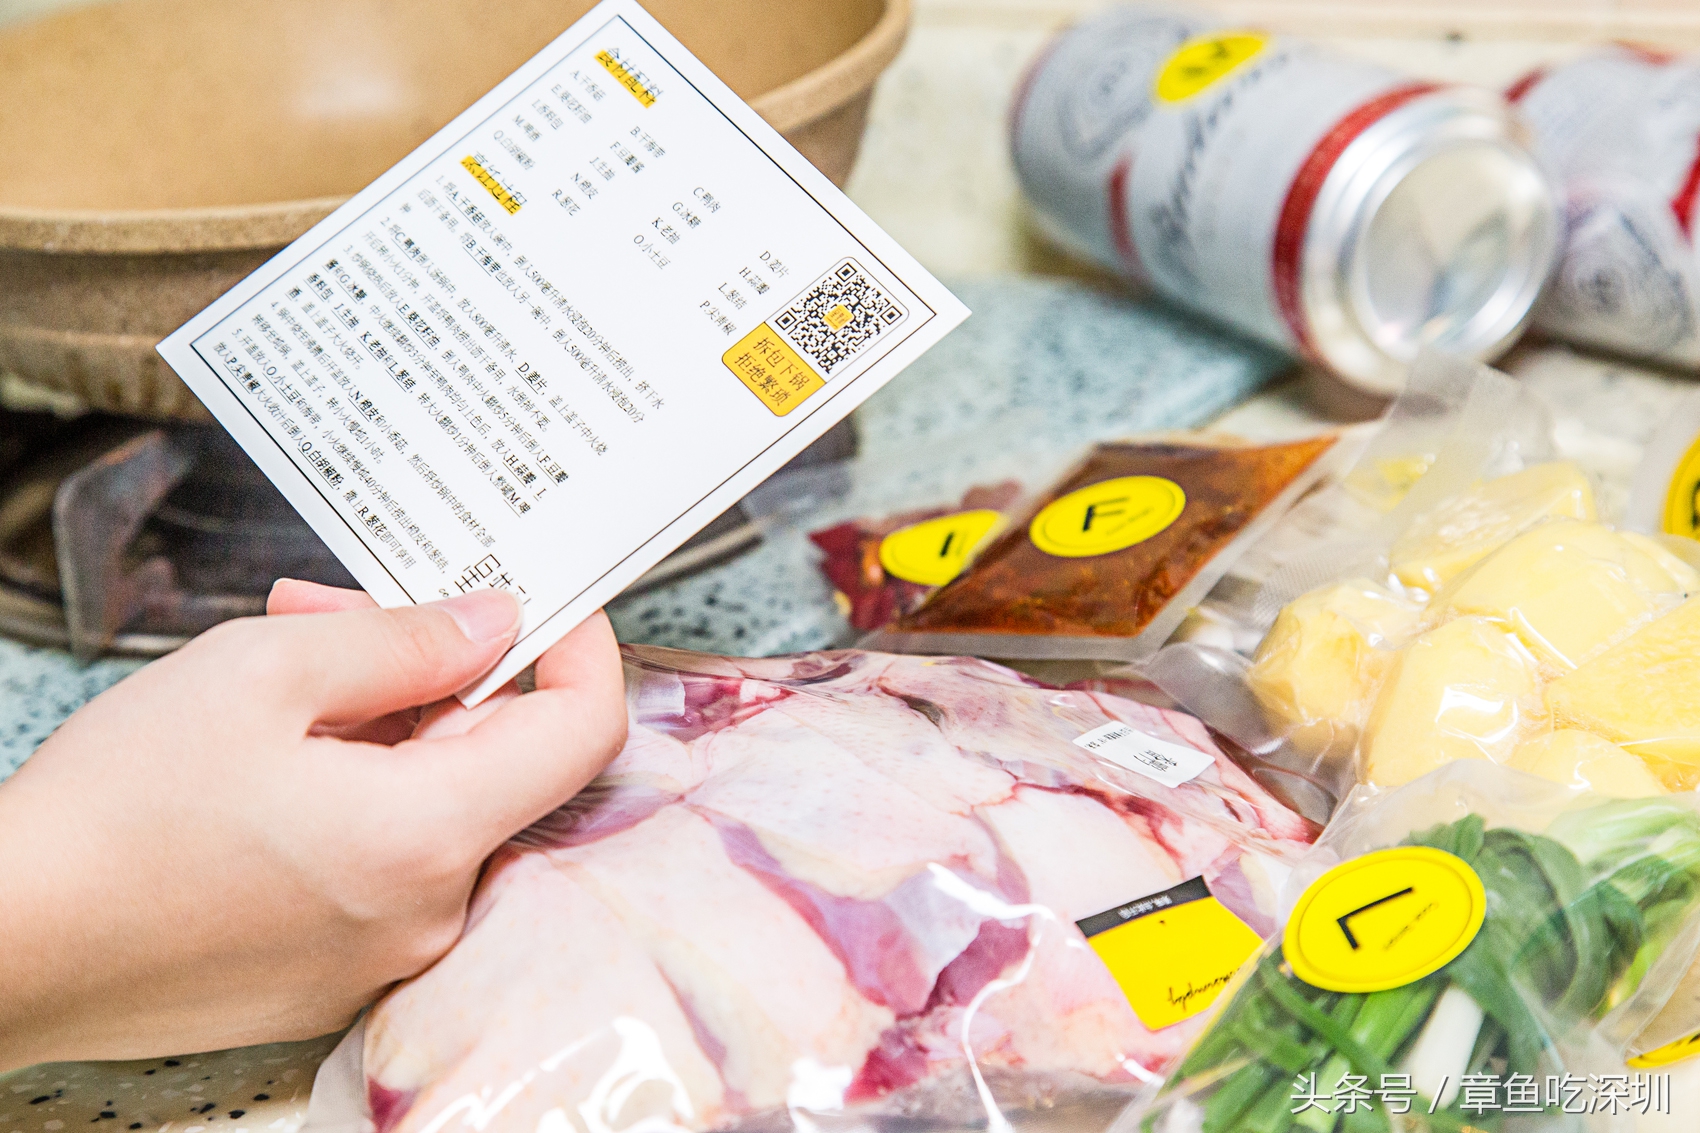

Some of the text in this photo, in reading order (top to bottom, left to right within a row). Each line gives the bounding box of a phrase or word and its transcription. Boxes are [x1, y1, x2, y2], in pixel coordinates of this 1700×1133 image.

[568, 66, 608, 102] A.干香菇
[596, 43, 666, 106] 食材配料
[529, 97, 566, 131] I.香料包
[549, 82, 594, 124] E.葵花籽油
[510, 112, 543, 143] M.啤酒
[628, 123, 668, 160] B.干海带
[490, 127, 537, 172] Q.白胡椒粉
[608, 139, 646, 175] F.豆瓣酱
[460, 149, 530, 215] 烹饪过程
[568, 170, 601, 200] N.橙皮
[587, 154, 618, 182] J.生抽
[549, 186, 582, 217] R.葱花
[669, 199, 703, 230] G.冰糖
[689, 184, 723, 214] C.鸭肉
[649, 215, 683, 245] K.老抽
[630, 231, 672, 270] O.小土豆
[756, 248, 792, 281] D.姜片
[716, 280, 749, 311] L.葱结
[736, 264, 771, 297] H.蒜瓣
[697, 298, 738, 336] P.尖青椒
[731, 349, 792, 407] 拒绝繁琐
[749, 334, 812, 393] 拆包下锅
[1082, 496, 1130, 532] F
[1336, 885, 1414, 951] L
